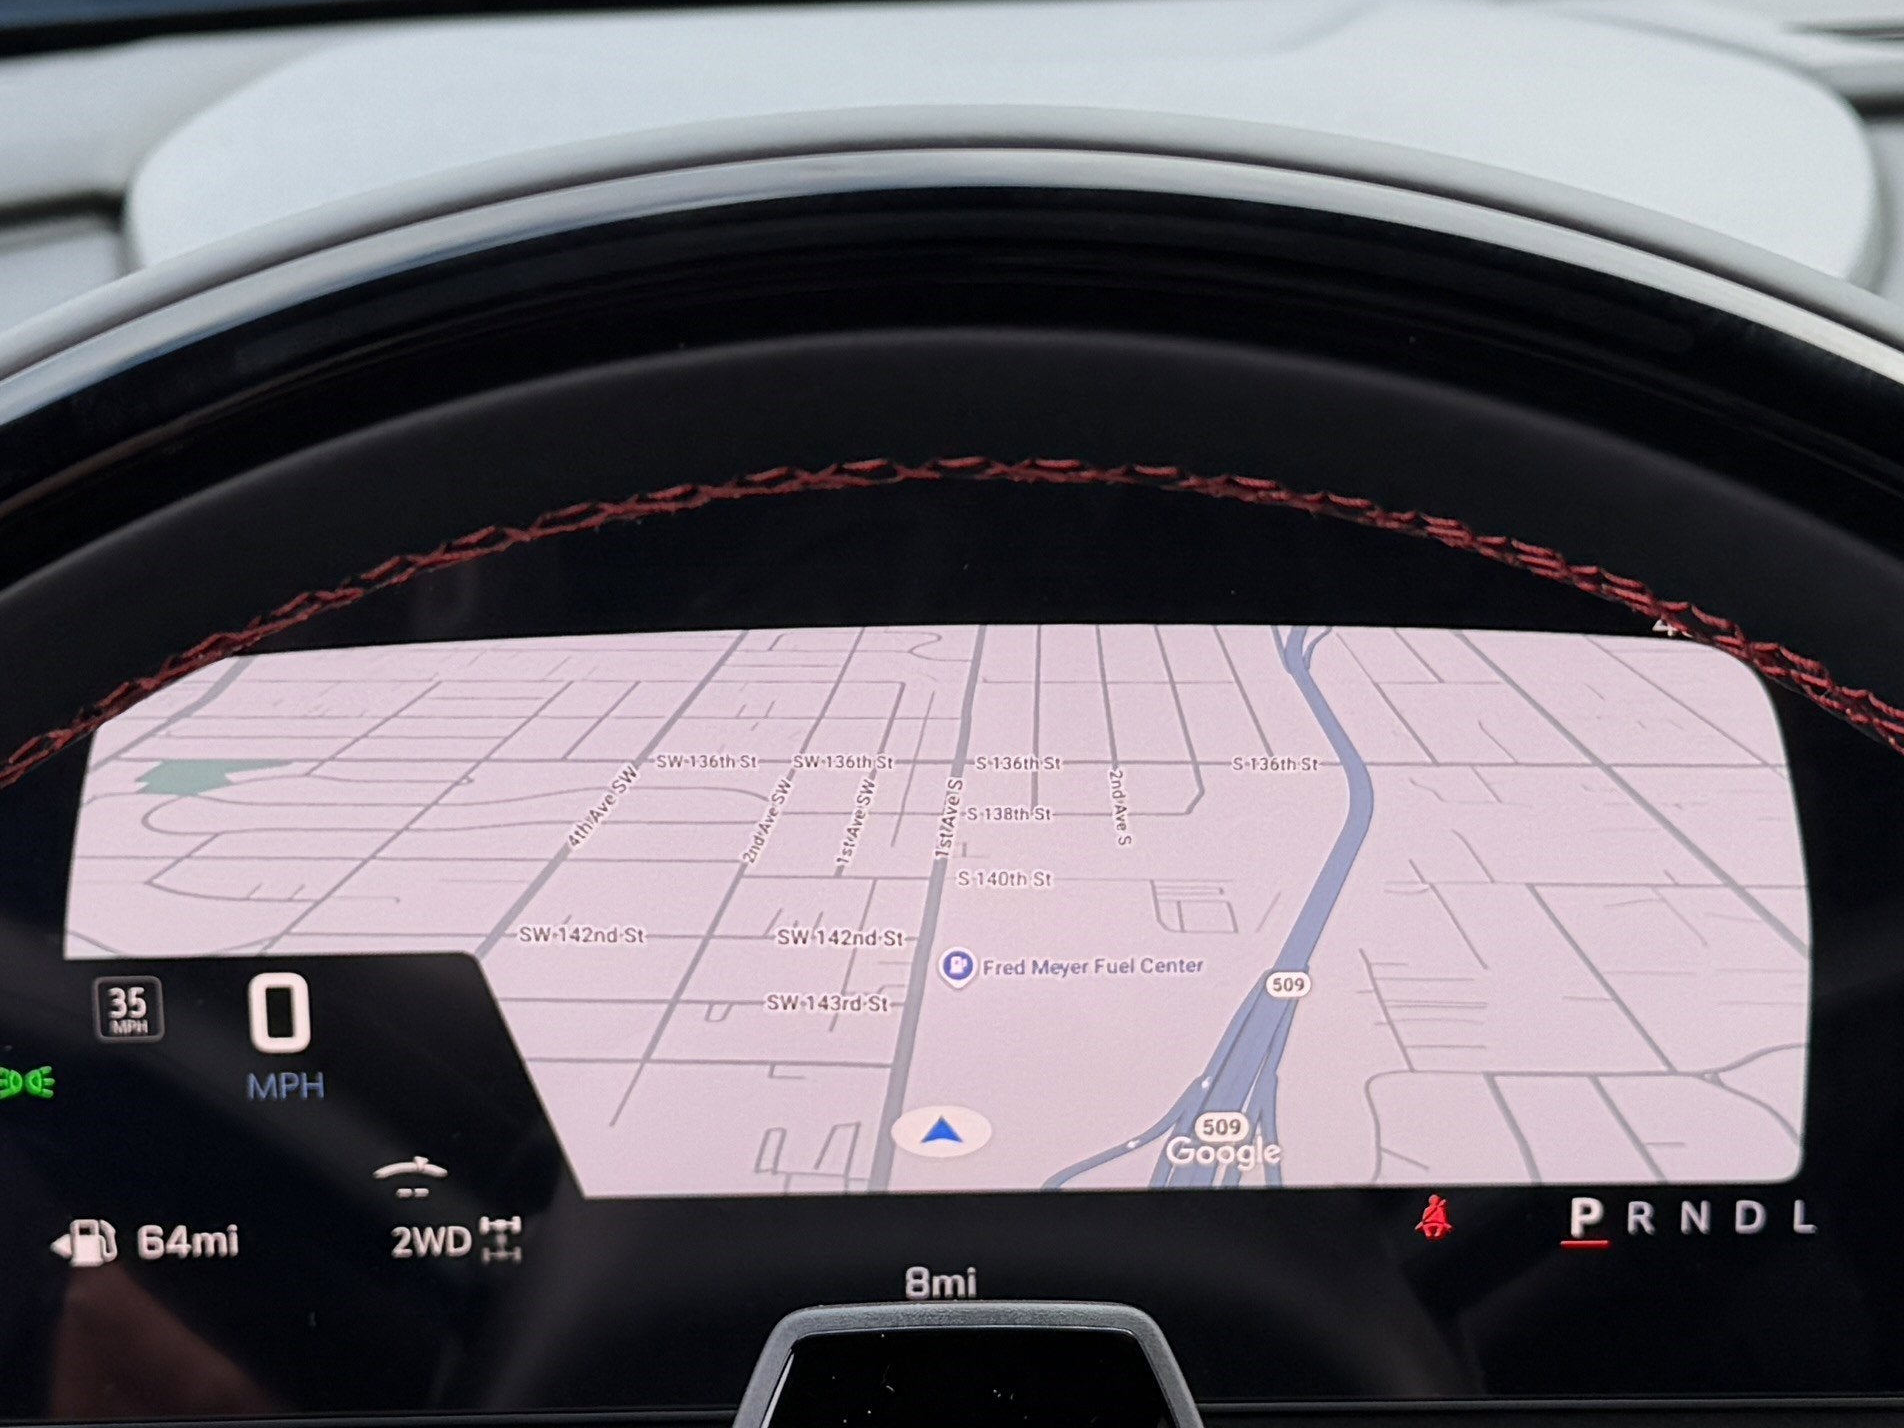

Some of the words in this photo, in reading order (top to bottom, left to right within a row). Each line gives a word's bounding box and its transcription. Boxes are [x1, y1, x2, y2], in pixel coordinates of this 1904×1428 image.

[657, 756, 683, 768] SW
[691, 755, 736, 768] 136th
[740, 755, 757, 769] St
[794, 756, 819, 769] SW
[827, 755, 872, 769] 136th
[876, 755, 893, 770] St
[976, 757, 986, 770] S
[994, 756, 1039, 770] 136th
[1044, 757, 1061, 771] St
[1232, 758, 1242, 771] S
[1250, 757, 1297, 771] 136th
[1301, 758, 1318, 772] St
[948, 778, 963, 791] S
[1109, 770, 1125, 800] 2nd
[569, 822, 594, 847] 4th
[589, 794, 616, 823] Ave
[612, 766, 637, 793] SW
[941, 791, 961, 827] Ave
[967, 807, 978, 821] S
[984, 806, 1030, 821] 138th
[1034, 807, 1051, 821] St
[1114, 802, 1128, 834] Ave
[742, 834, 766, 864] 2nd
[758, 807, 778, 835] Ave
[771, 779, 792, 804] SW
[836, 840, 854, 864] 1st
[847, 809, 866, 840] Ave
[857, 779, 875, 807] SW
[935, 826, 952, 858] 1st
[1118, 835, 1132, 846] S
[958, 872, 970, 886] S
[976, 871, 1027, 886] 140th
[1034, 872, 1053, 887] St
[519, 927, 549, 942] SW
[558, 927, 618, 943] 142nd
[624, 927, 644, 943] St
[777, 929, 809, 945] SW
[817, 929, 877, 946] 142nd
[884, 930, 903, 946] St
[984, 960, 1025, 975] Fred
[1032, 960, 1088, 980] Meyer
[1095, 959, 1134, 974] Fuel
[1140, 958, 1203, 974] Center
[1273, 977, 1305, 993] 509
[106, 986, 148, 1020] 35
[247, 972, 311, 1054] 0
[767, 994, 798, 1011] SW
[807, 995, 861, 1012] 143rd
[868, 995, 888, 1012] St
[109, 1020, 149, 1036] MPH
[247, 1072, 325, 1100] MPH
[1203, 1119, 1241, 1136] 509
[1166, 1135, 1282, 1171] Google
[1570, 1196, 1604, 1240] P
[1627, 1200, 1656, 1236] R
[1681, 1200, 1712, 1235] N
[1734, 1199, 1768, 1235] D
[1793, 1199, 1818, 1235] L
[137, 1223, 240, 1260] 64mi
[391, 1225, 473, 1259] 2WD
[905, 1266, 978, 1300] 8mi
